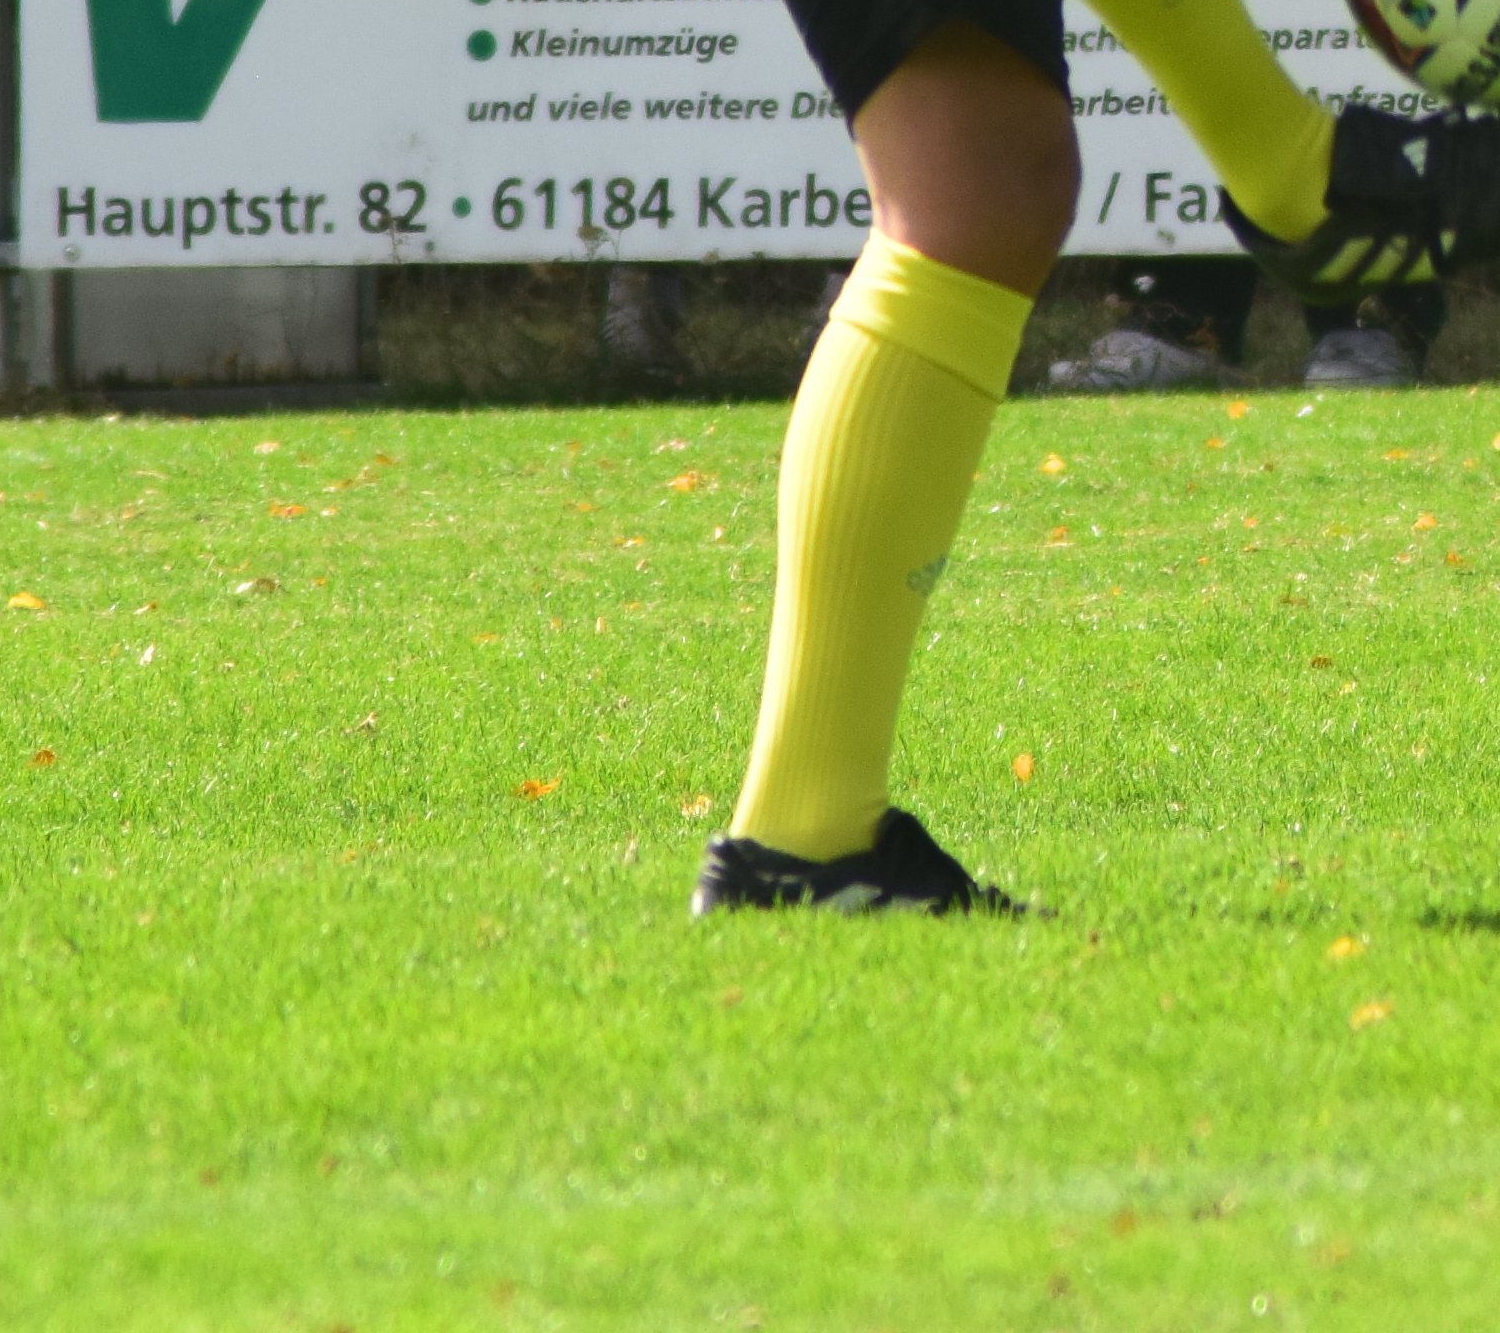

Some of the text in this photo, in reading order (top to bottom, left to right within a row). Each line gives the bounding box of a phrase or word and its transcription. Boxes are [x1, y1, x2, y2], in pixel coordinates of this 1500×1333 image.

[509, 27, 739, 64] Kleinumzüge
[467, 93, 536, 123] und
[549, 91, 632, 121] viele
[645, 91, 780, 120] weitere
[56, 186, 335, 250] Hauptstr.
[358, 179, 428, 235] 82
[491, 177, 675, 230] 61184
